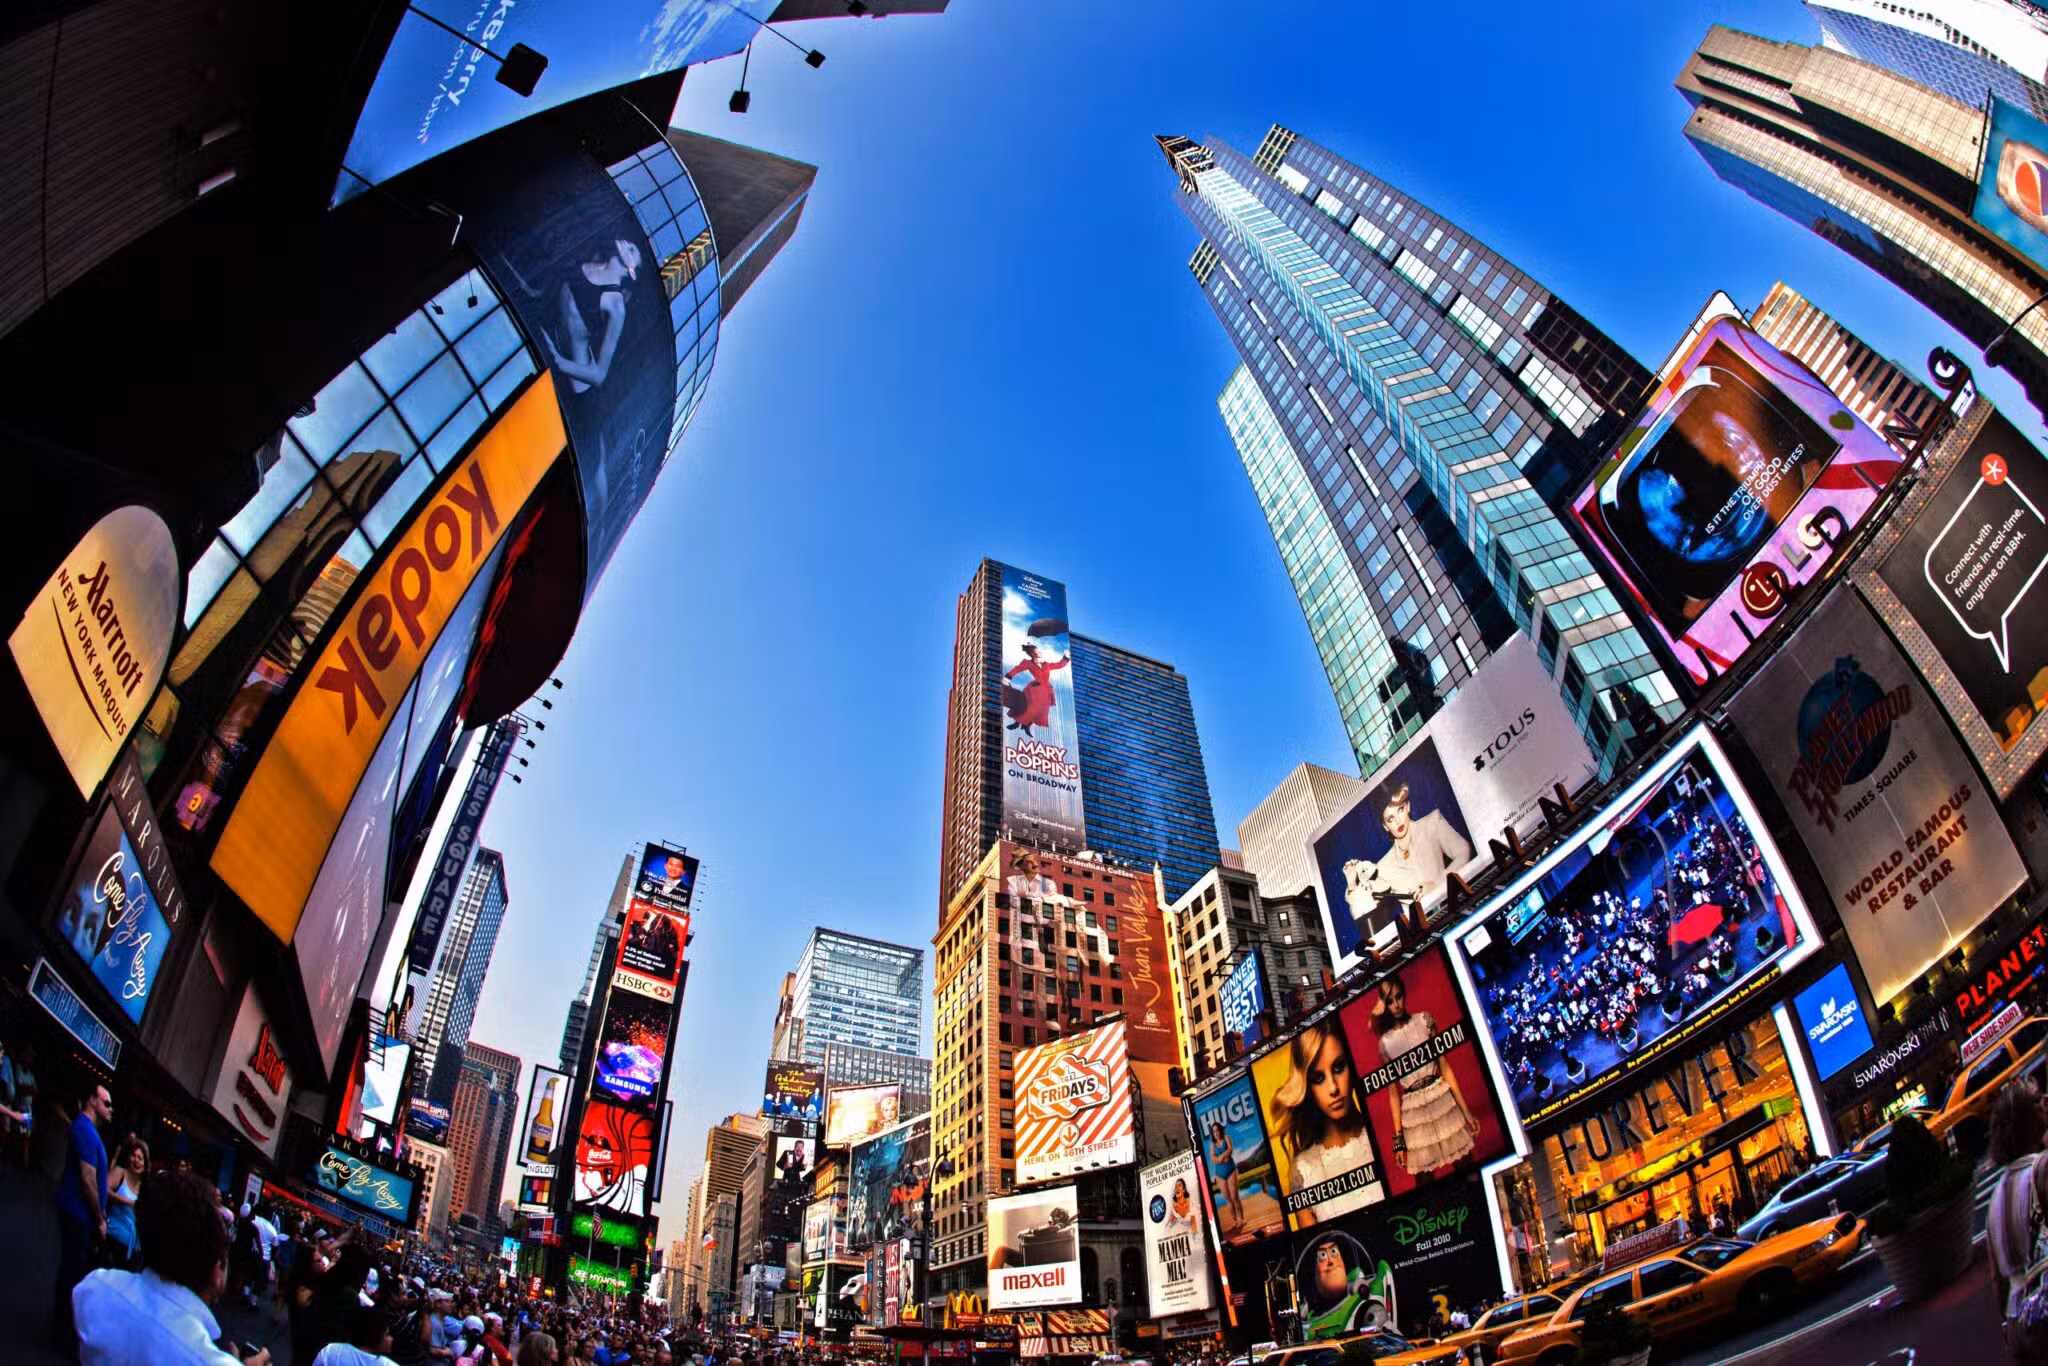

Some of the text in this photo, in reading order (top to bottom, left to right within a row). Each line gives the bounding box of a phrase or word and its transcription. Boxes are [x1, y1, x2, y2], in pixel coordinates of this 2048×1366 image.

[444, 0, 491, 79] rry.com
[1704, 462, 1766, 534] IS IT THE TRIUMPH
[1739, 458, 1783, 507] OF GOOD
[1742, 444, 1807, 520] OVER DUST MITES?
[1943, 523, 1993, 584] Connect with
[1953, 508, 2025, 596] friends in real-time,
[1963, 531, 2027, 609] anytime on BBM.
[315, 460, 500, 736] Kodak
[57, 568, 128, 737] NEW YORK MARQUIS
[78, 561, 145, 698] Marriott
[1017, 737, 1067, 762] MARY
[1483, 707, 1537, 762] TOUS
[1005, 748, 1079, 780] POPPINS
[1008, 768, 1077, 794] ON BROADWAY
[1843, 750, 1919, 823] TIMES SQUARE
[118, 764, 186, 923] MARQUIS
[1062, 855, 1106, 873] Colombian
[1844, 783, 1973, 907] WORLD FAMOUS
[1867, 814, 1971, 915] RESTAURANT
[94, 851, 126, 912] Come
[421, 824, 472, 936] SQUARE
[1902, 858, 1956, 912] & BAR
[1122, 878, 1152, 945] Valdez
[122, 931, 153, 1001] Away
[617, 973, 653, 993] HSBC
[1126, 959, 1161, 1008] Juan
[1219, 951, 1257, 999] WINNER!
[1956, 923, 2048, 1019] PLANET
[1222, 983, 1259, 1029] BEST
[1682, 1025, 1695, 1036] you
[1749, 974, 1771, 990] happy
[1809, 999, 1858, 1041] SWAROVSKI
[1979, 1024, 1999, 1047] SIDE
[1998, 1007, 2020, 1034] STORY
[774, 1073, 817, 1087] Addams
[1363, 1024, 1466, 1092] FOREVER21.COM
[1855, 1033, 1922, 1089] SWAROVSKI
[604, 1075, 650, 1096] SAMSUNG
[777, 1081, 813, 1098] Family
[1557, 1032, 1766, 1177] FOREVER
[1200, 1091, 1256, 1136] HUGE
[526, 1164, 556, 1176] INGLOT
[1024, 1139, 1118, 1166] HERE ON 46TH STREET
[1155, 1161, 1176, 1174] WORLD'S
[1177, 1154, 1192, 1164] MOST
[319, 1151, 350, 1174] Come
[338, 1157, 375, 1187] Fly
[367, 1180, 404, 1211] Away
[1287, 1164, 1376, 1212] FOREVER21.COM
[1158, 1236, 1191, 1264] MAMMA
[1416, 1232, 1452, 1252] Fall 2010
[1608, 1226, 1670, 1254] FLASHDANCERS
[874, 1247, 886, 1309] PALACE
[1003, 1268, 1065, 1291] maxell
[1166, 1259, 1187, 1283] MIA!
